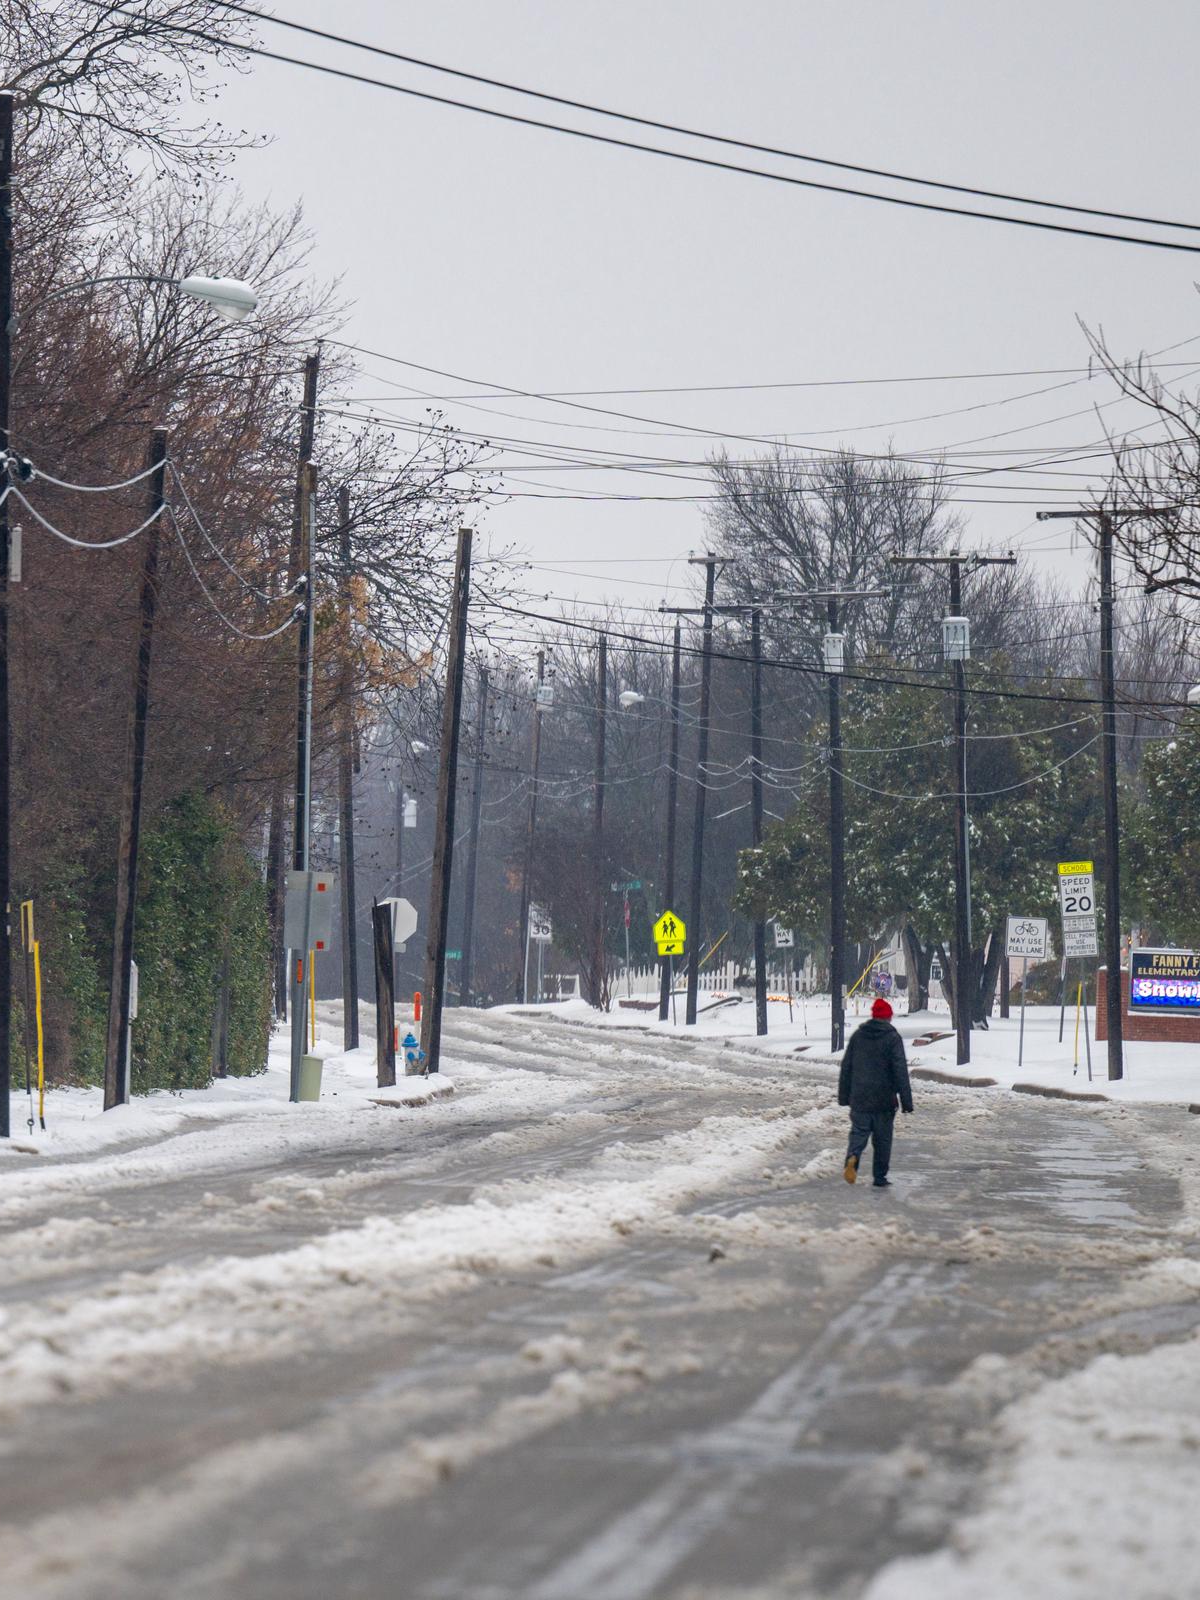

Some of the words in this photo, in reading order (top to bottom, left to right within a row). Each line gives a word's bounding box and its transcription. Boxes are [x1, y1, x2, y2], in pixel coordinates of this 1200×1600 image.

[1062, 864, 1088, 873] SCHOOL
[1061, 877, 1090, 886] SPEED
[1065, 887, 1087, 895] LIMIT
[1065, 896, 1092, 912] 20
[532, 924, 550, 936] 30
[1008, 945, 1025, 953] FULL
[1026, 946, 1044, 954] LANE
[1152, 954, 1190, 968] FANNY
[1137, 967, 1200, 977] ELEMENTARY
